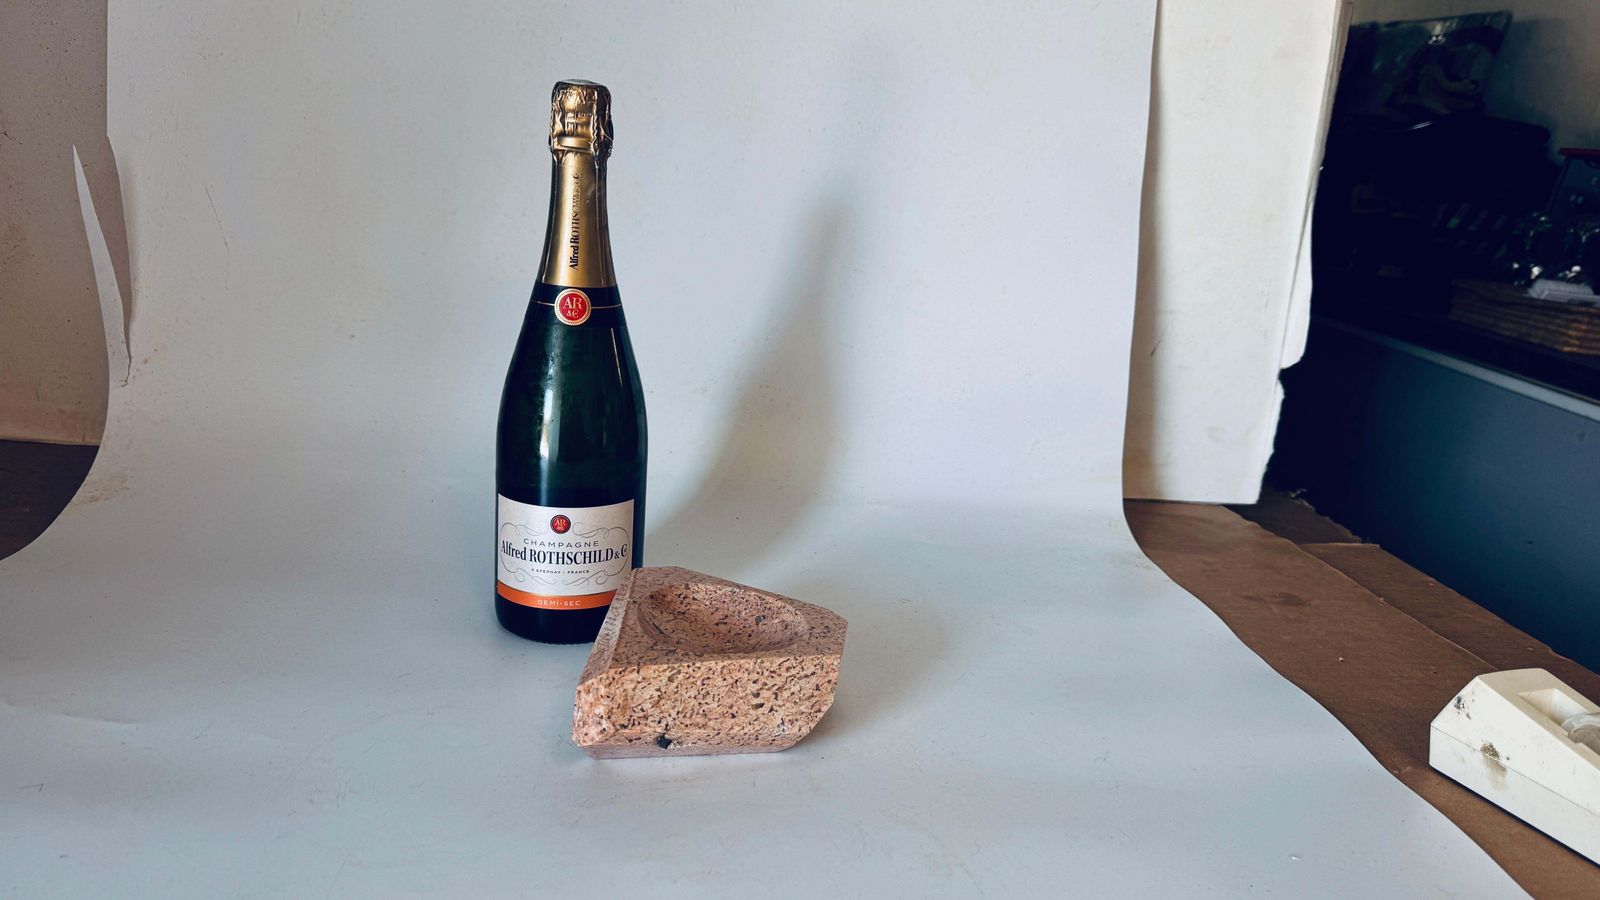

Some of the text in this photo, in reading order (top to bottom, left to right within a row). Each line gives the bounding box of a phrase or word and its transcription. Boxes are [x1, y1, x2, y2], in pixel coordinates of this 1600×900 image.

[569, 245, 579, 270] Alfred
[562, 296, 583, 310] AR
[523, 538, 599, 549] CHAMPAGNE
[500, 540, 527, 561] Alfred
[529, 547, 614, 565] ROTHSCHILD
[537, 599, 581, 607] DEMI-SEC
